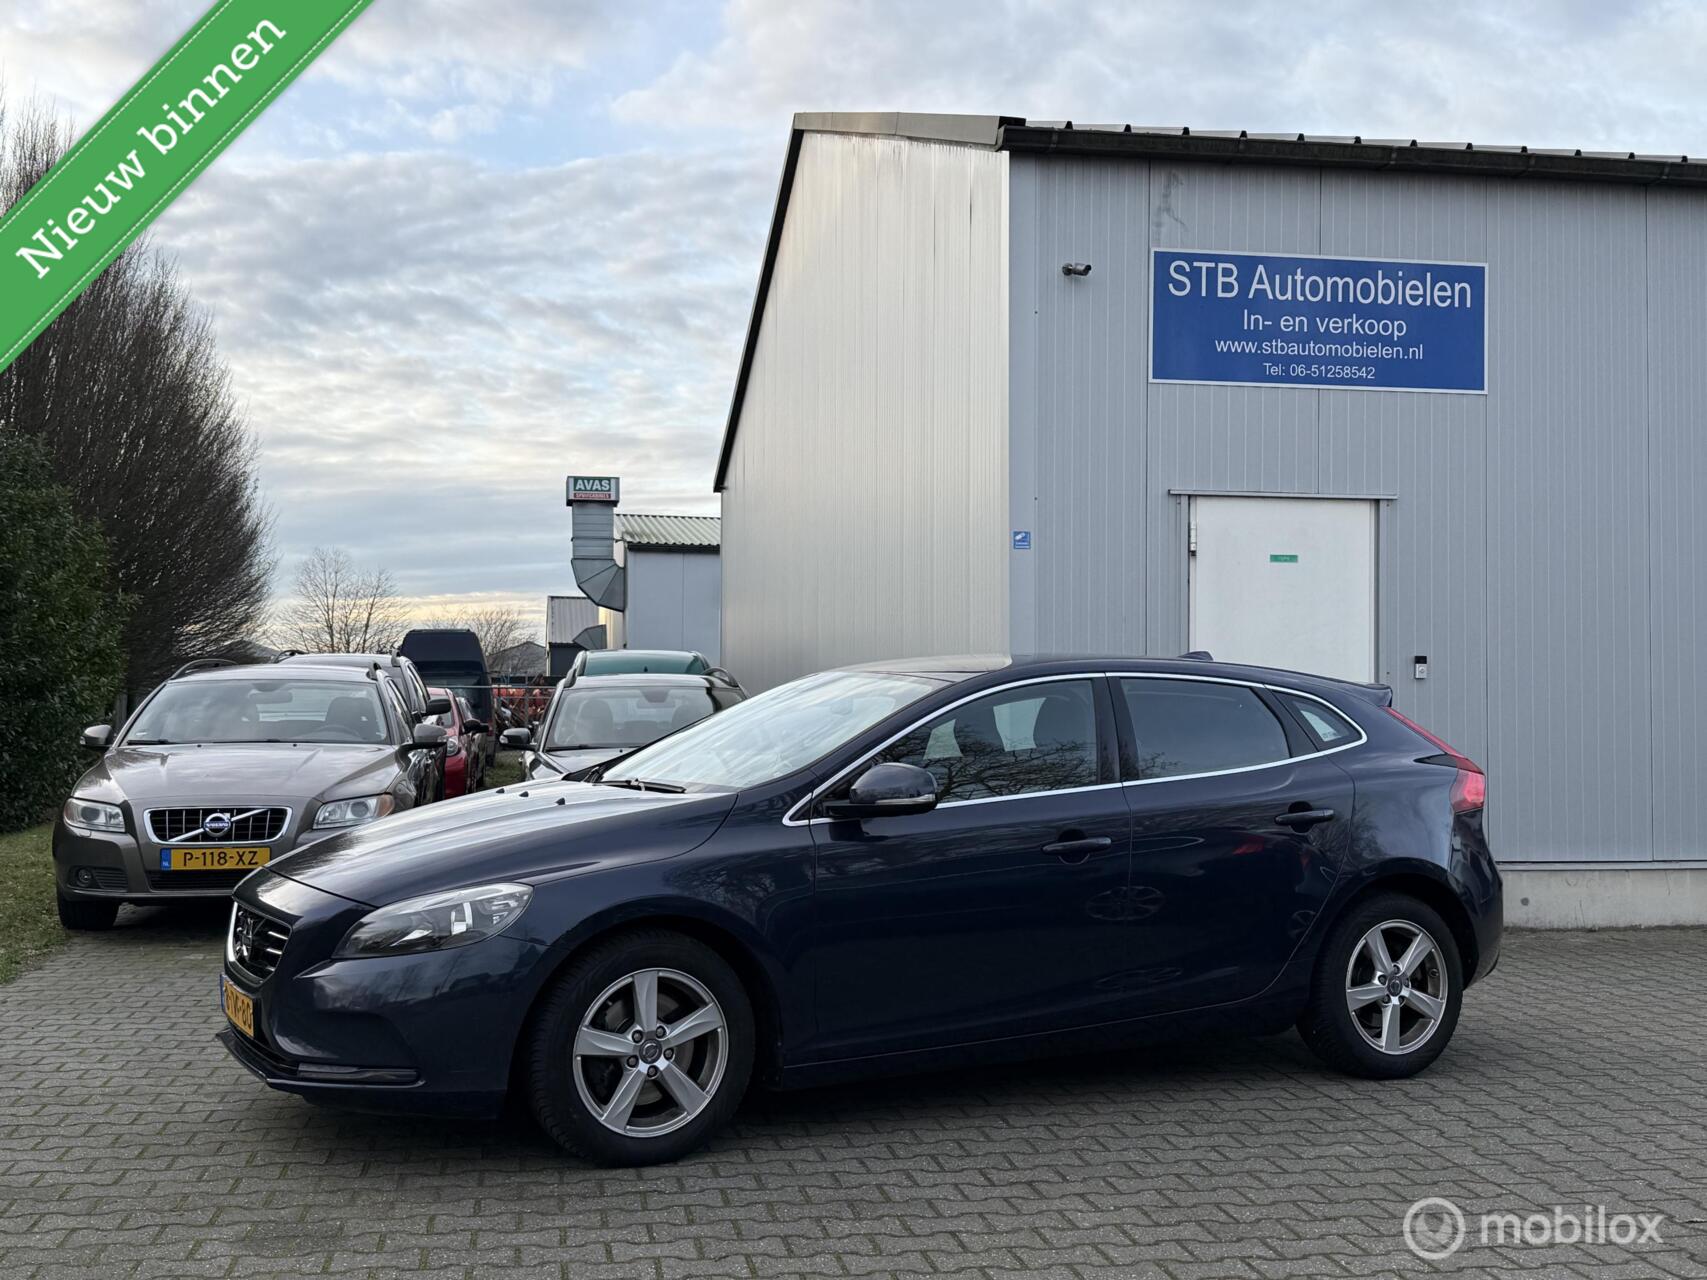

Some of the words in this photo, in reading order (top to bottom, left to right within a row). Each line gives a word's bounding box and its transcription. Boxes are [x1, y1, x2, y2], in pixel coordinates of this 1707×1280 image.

[1167, 260, 1239, 298] STB
[1248, 264, 1472, 308] Automobielen
[1243, 309, 1273, 331] In-
[1280, 315, 1308, 333] en
[1316, 313, 1407, 341] verkoop
[1215, 338, 1424, 360] www.stbautomobielen.nl
[1263, 362, 1286, 376] Tel:
[1289, 363, 1376, 379] 06-51258542
[575, 479, 610, 491] AVAS
[183, 850, 259, 867] P-118-XZ
